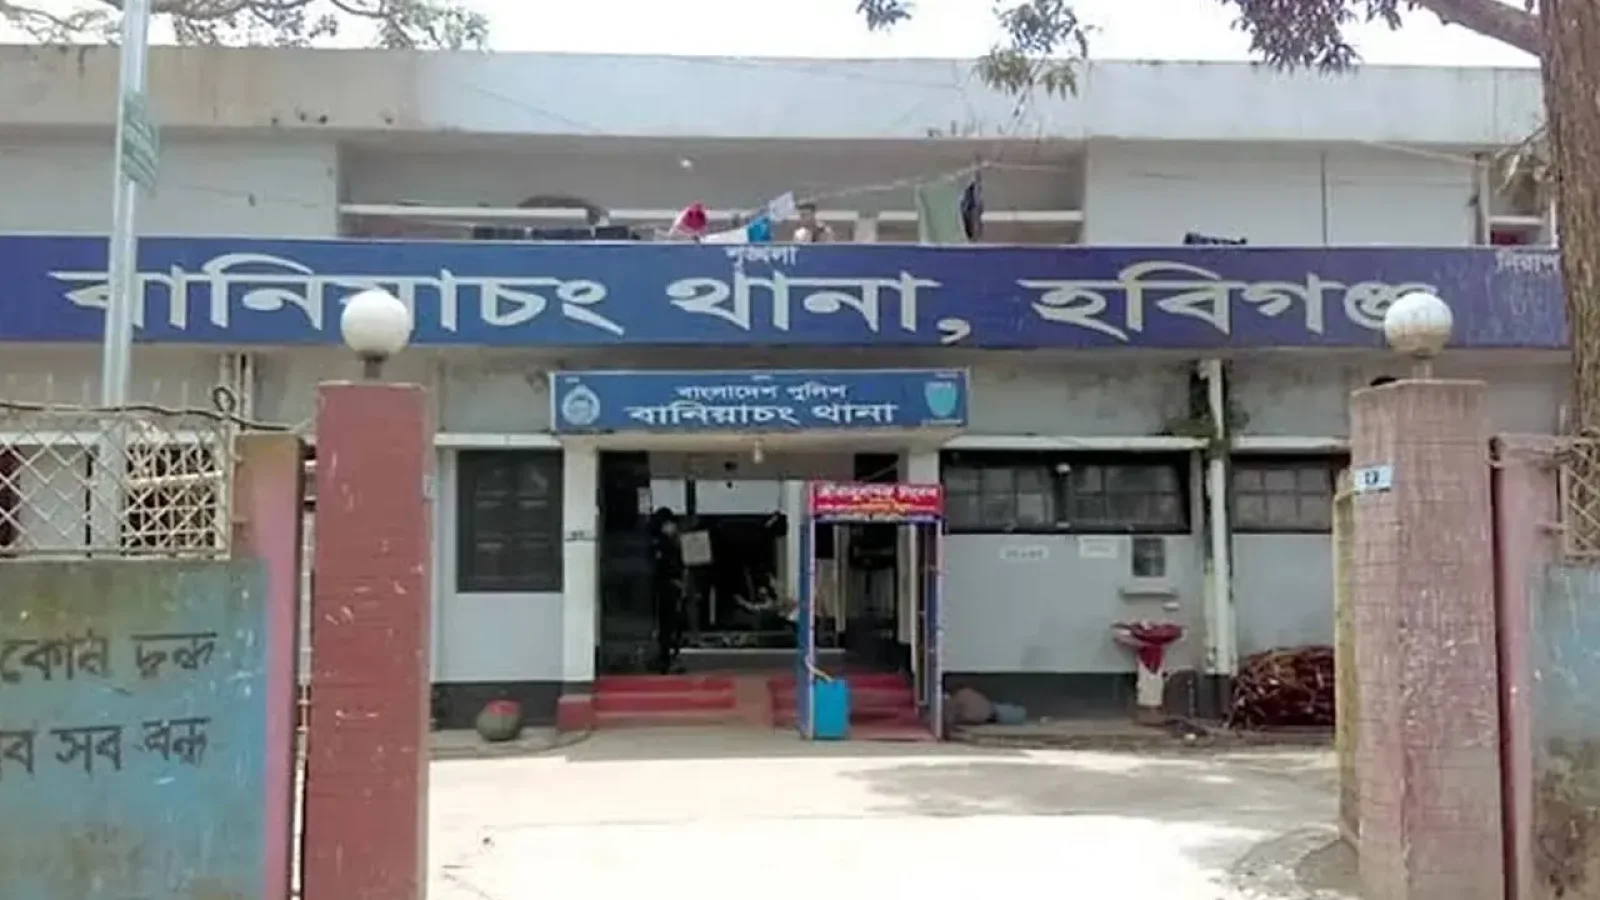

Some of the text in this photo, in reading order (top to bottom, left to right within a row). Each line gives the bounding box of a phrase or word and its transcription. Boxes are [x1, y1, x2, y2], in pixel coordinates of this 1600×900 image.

[666, 269, 971, 344] থানা,
[675, 382, 847, 401] বাংলাদেশ পুলিশ
[627, 400, 898, 425] বানিয়াচং থানা
[49, 724, 125, 775] সব
